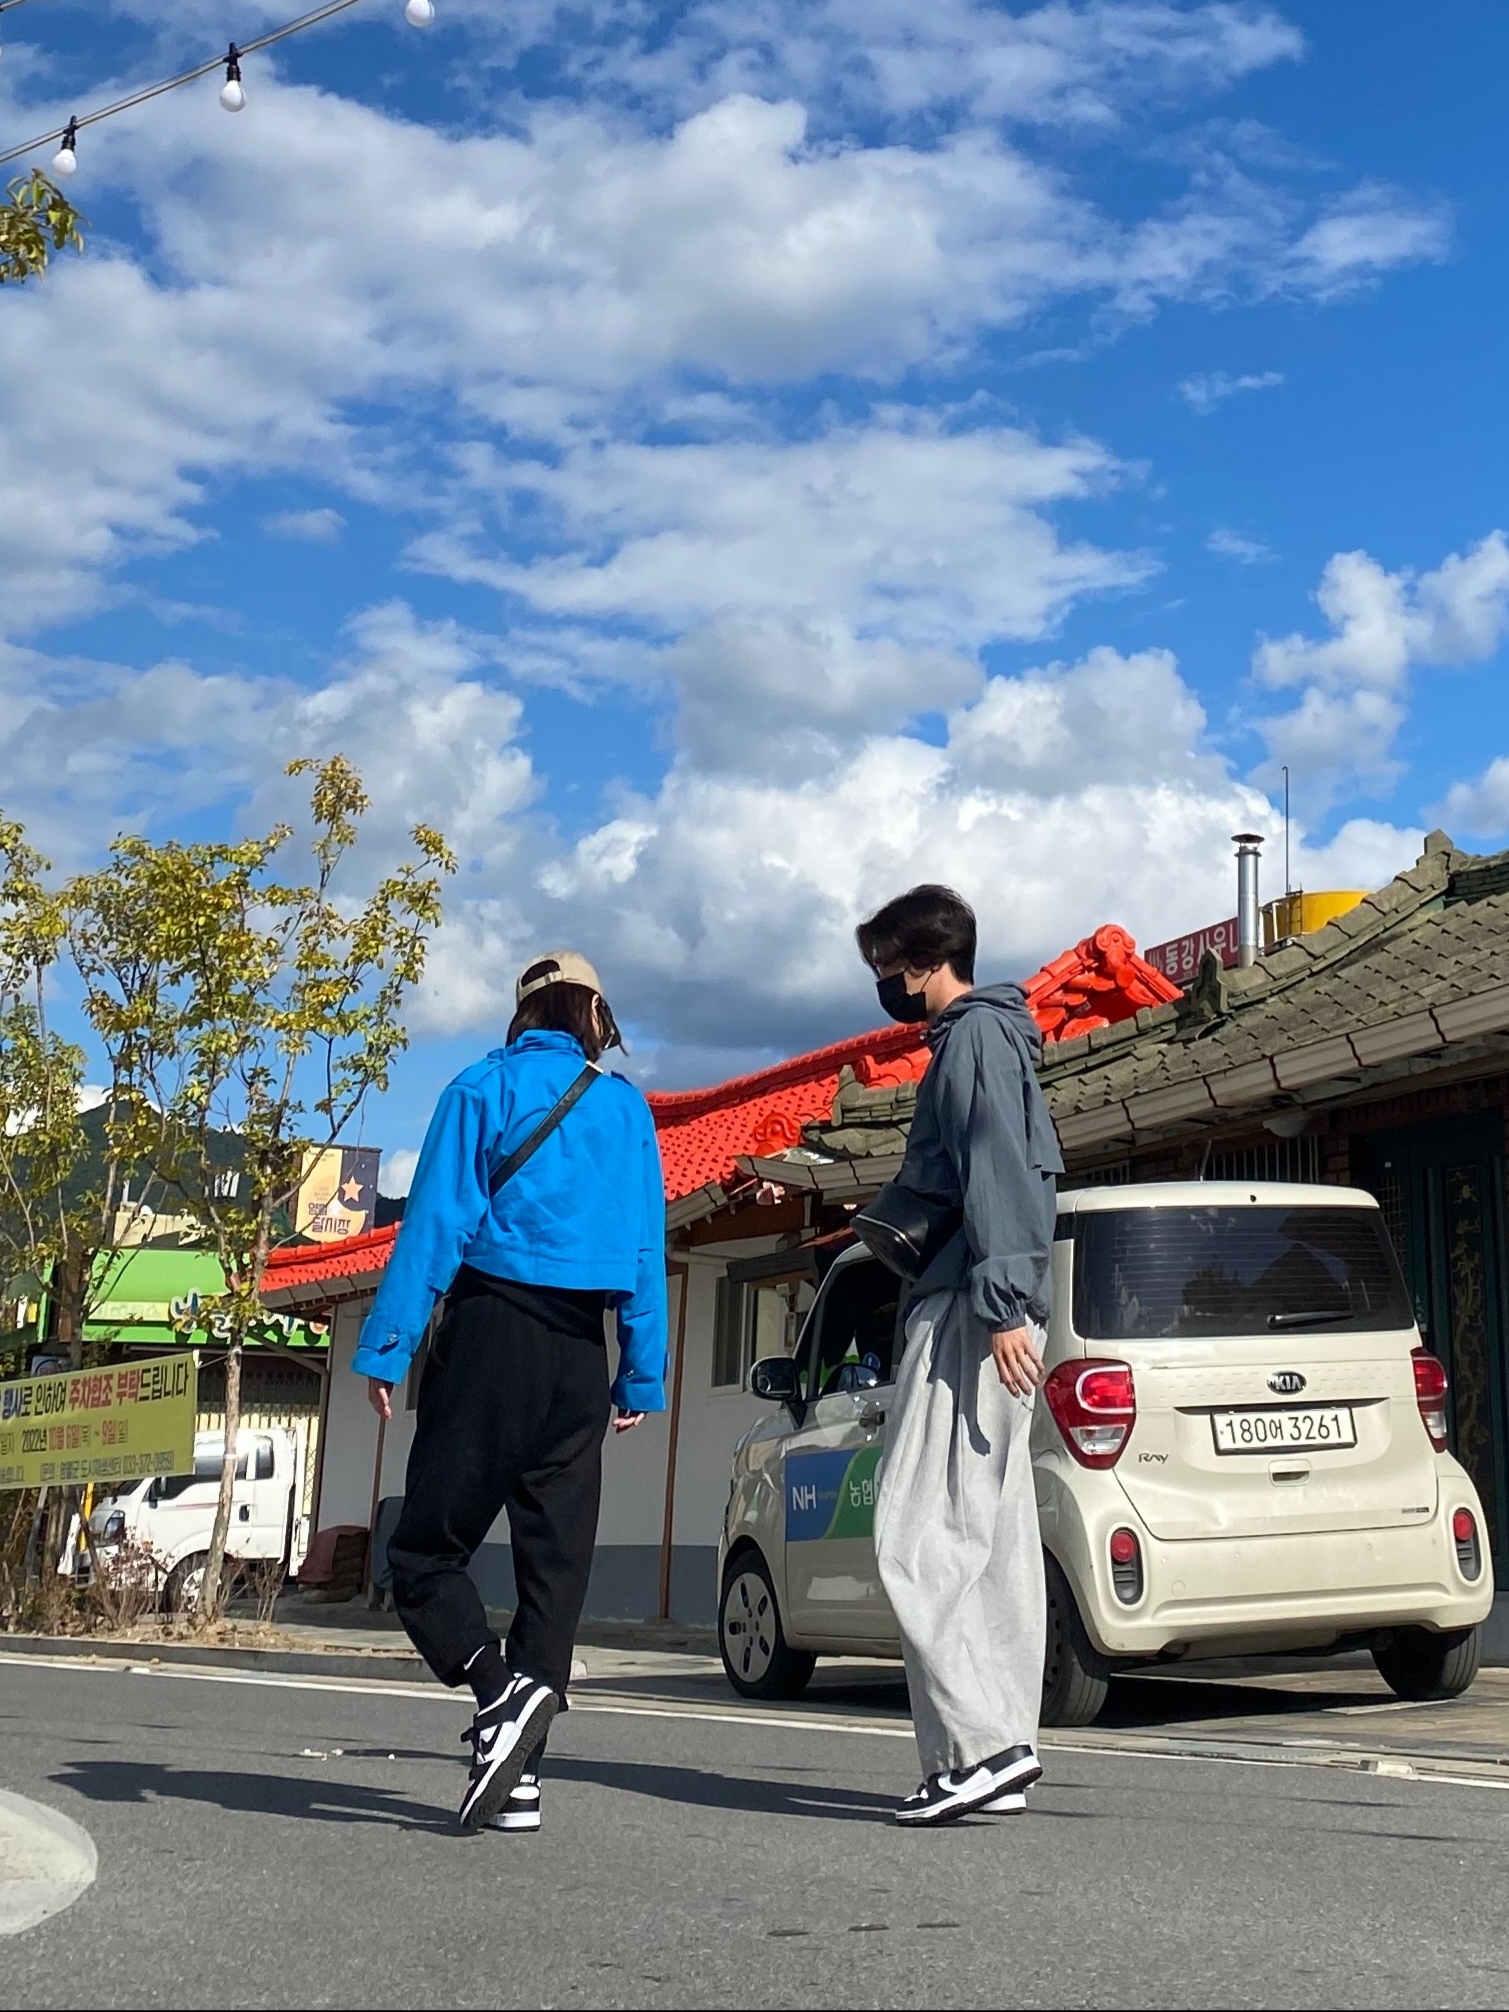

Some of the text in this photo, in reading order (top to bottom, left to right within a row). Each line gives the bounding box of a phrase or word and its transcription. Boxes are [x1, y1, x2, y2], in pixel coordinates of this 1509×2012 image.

[34, 1380, 67, 1416] 인하여
[69, 1373, 114, 1411] 주차협조
[115, 1361, 189, 1406] 부탁드립니다
[1274, 1374, 1302, 1391] KIA
[22, 1428, 47, 1453] 2022년
[1289, 1414, 1343, 1442] 3261
[792, 1484, 817, 1511] NH
[850, 1479, 874, 1508] 농협
